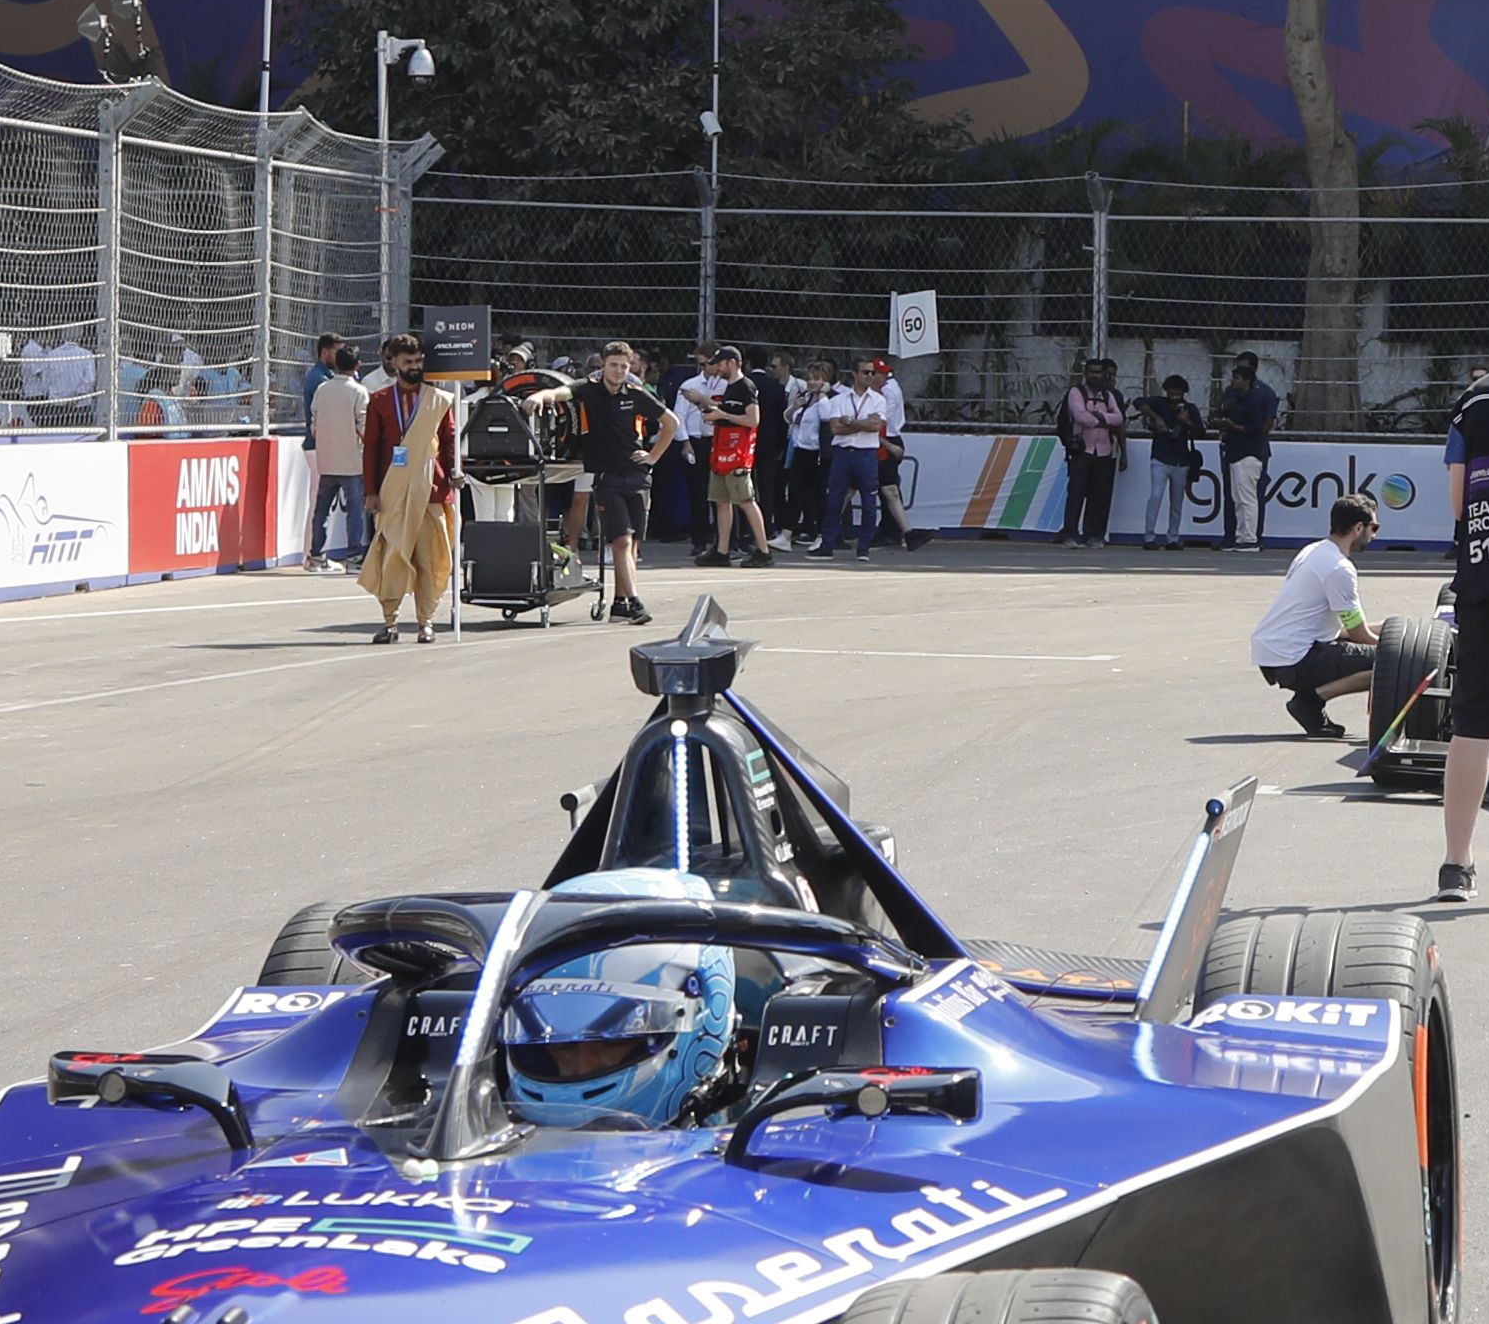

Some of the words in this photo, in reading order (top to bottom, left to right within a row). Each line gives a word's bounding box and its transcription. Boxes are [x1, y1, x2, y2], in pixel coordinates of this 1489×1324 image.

[904, 316, 923, 333] 50
[176, 455, 240, 509] AM/NS
[175, 510, 219, 556] INDIA
[406, 1015, 461, 1037] CRAF
[767, 1024, 838, 1048] CRAFT
[134, 1217, 313, 1249] HPE
